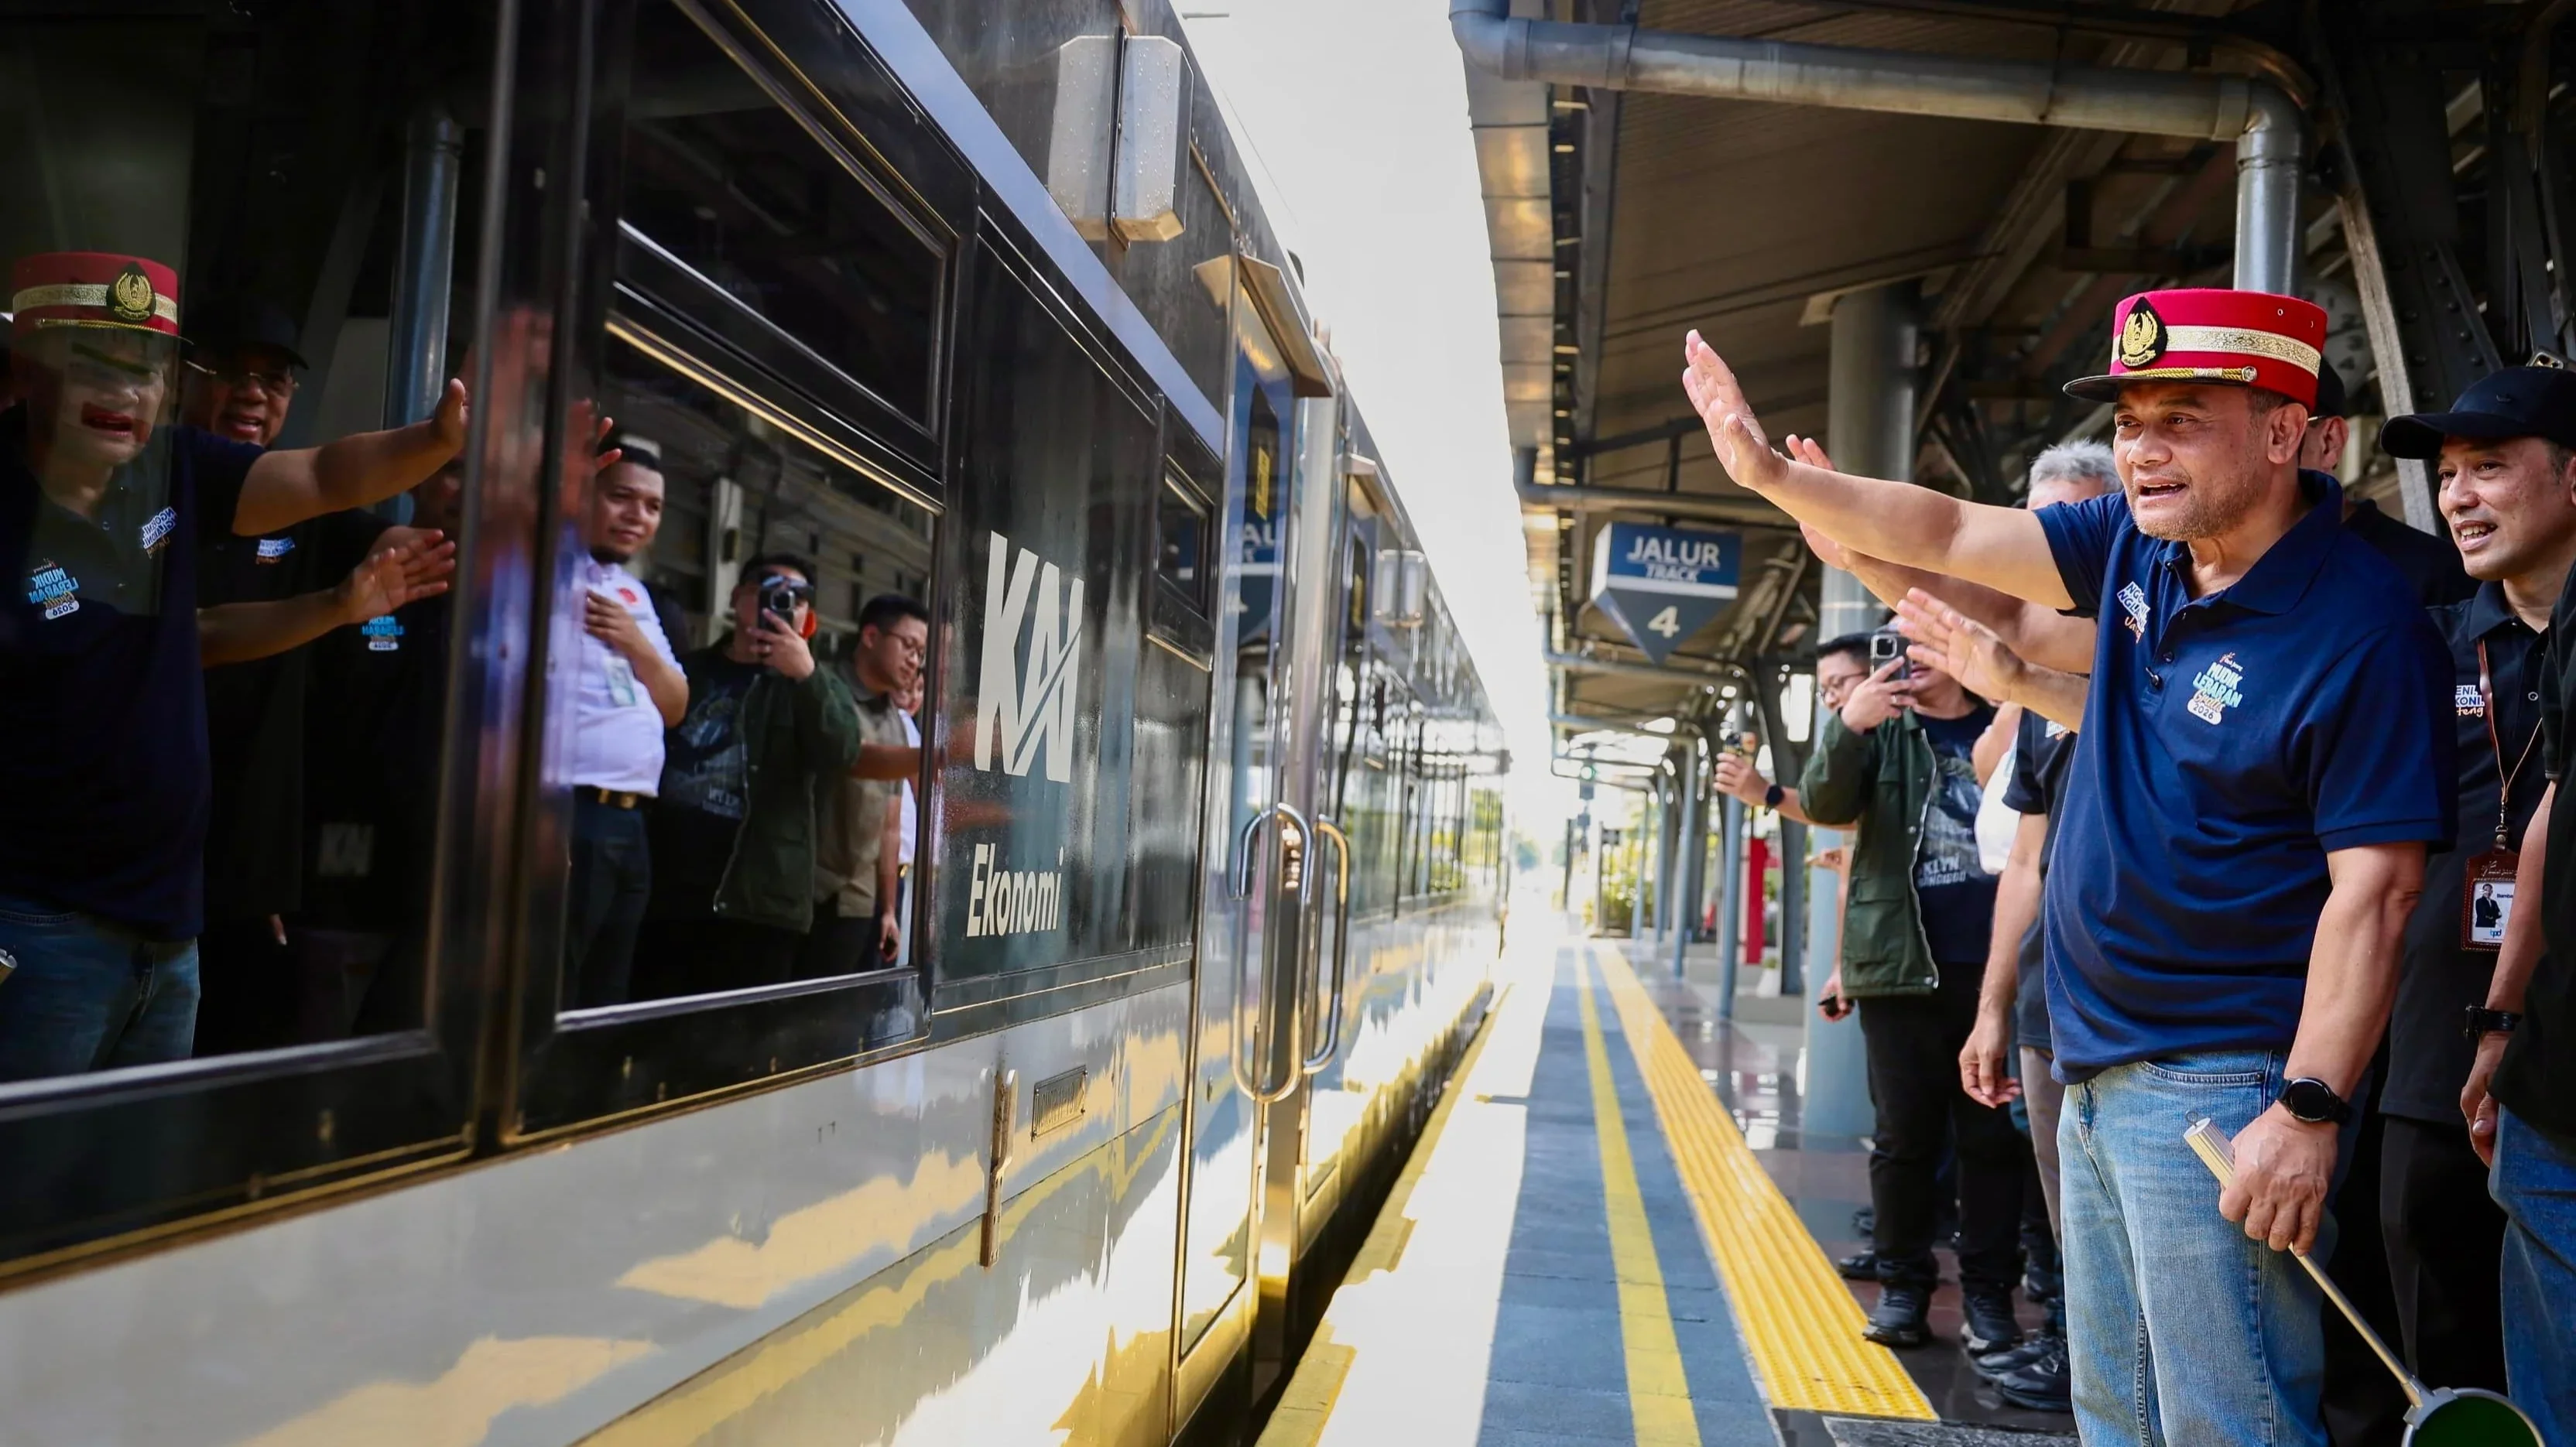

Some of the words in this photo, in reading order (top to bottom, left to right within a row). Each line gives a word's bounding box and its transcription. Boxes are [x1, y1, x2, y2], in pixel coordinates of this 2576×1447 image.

[1626, 535, 1720, 569] JALUR
[1646, 563, 1701, 584] TRACK
[1648, 605, 1680, 639] 4
[974, 530, 1084, 783] KAI
[2192, 671, 2243, 708] LEBARAN
[2206, 662, 2243, 690] MUDIK
[2193, 703, 2214, 720] 2026
[966, 843, 1064, 937] Ekonomi
